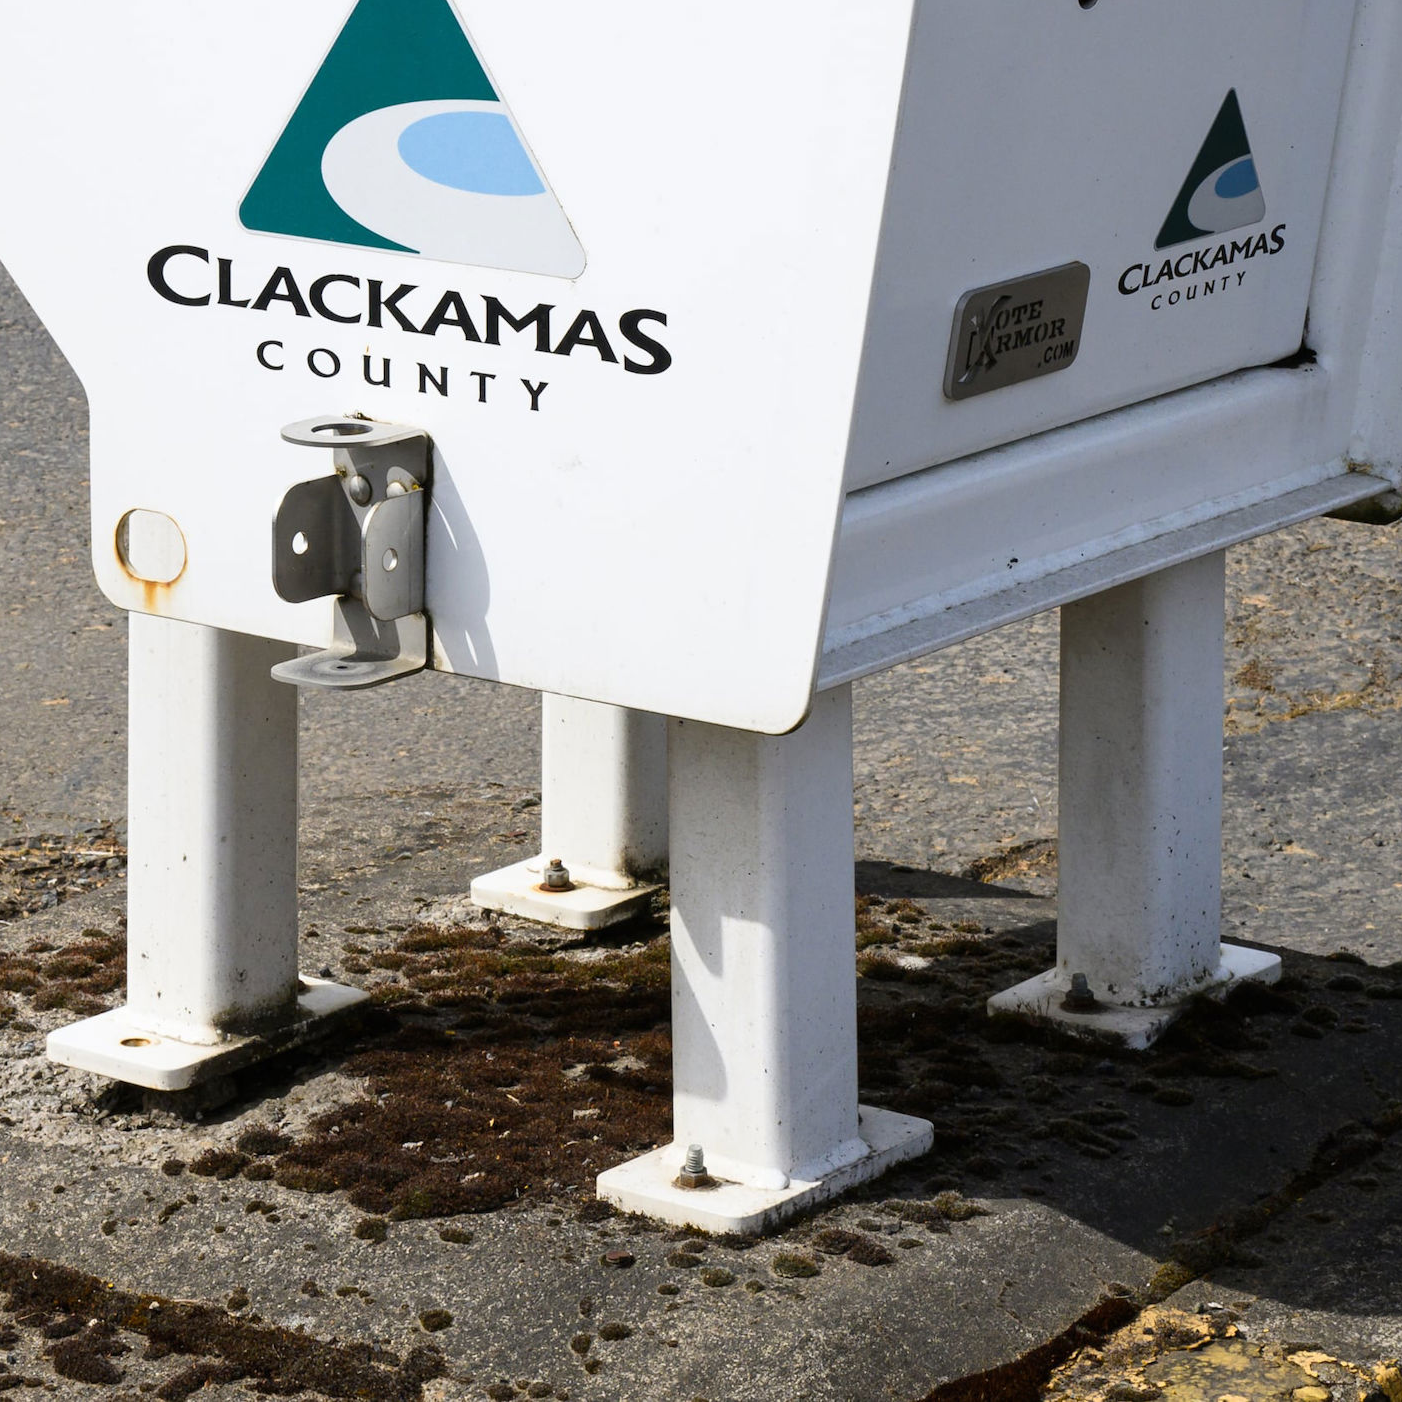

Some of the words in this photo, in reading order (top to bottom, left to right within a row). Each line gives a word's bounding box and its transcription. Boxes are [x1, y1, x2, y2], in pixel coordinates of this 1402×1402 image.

[1118, 224, 1286, 295] CLACKAMAS
[1151, 271, 1246, 310] COUNTY
[146, 244, 672, 375] CLACKAMAS
[256, 340, 548, 411] COUNTY
